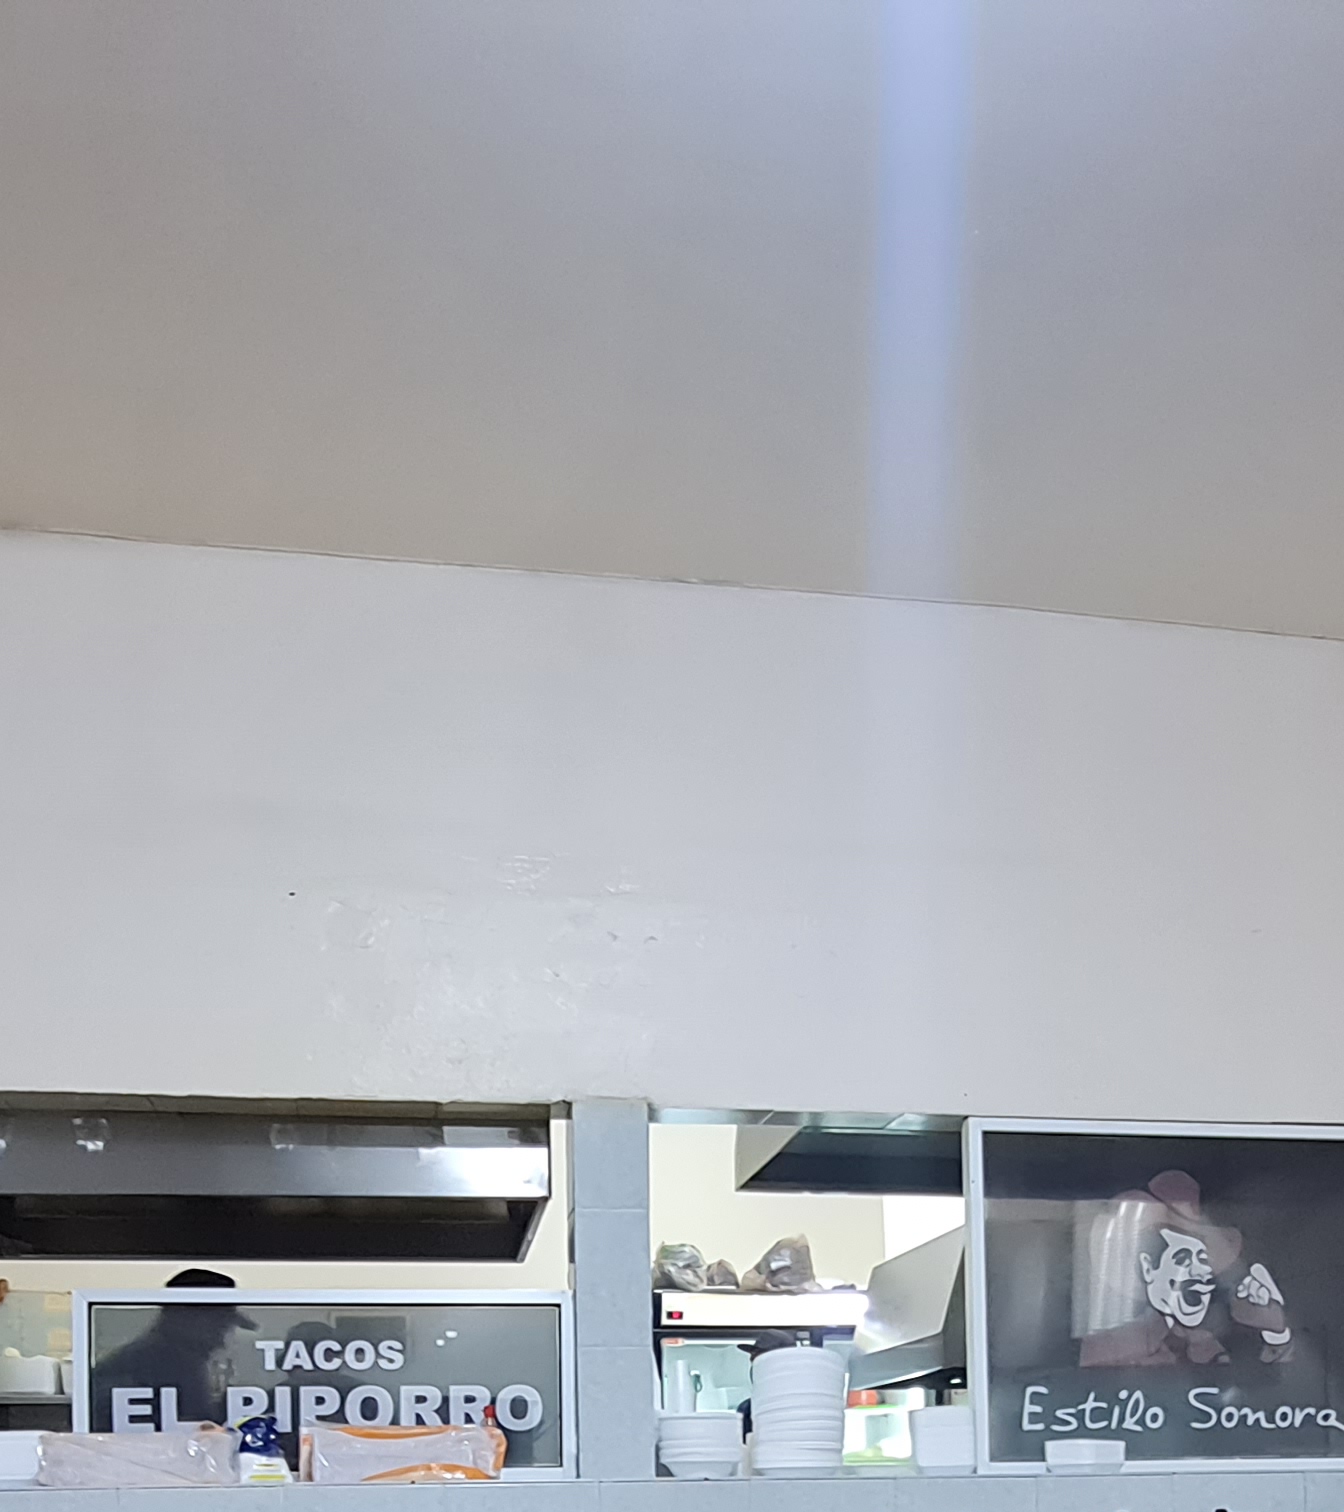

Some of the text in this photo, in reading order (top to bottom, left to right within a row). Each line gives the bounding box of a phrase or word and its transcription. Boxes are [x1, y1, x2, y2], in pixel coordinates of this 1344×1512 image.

[255, 1339, 405, 1371] TACOS
[111, 1384, 544, 1433] EL PIPORRO
[1021, 1386, 1165, 1432] Estilo
